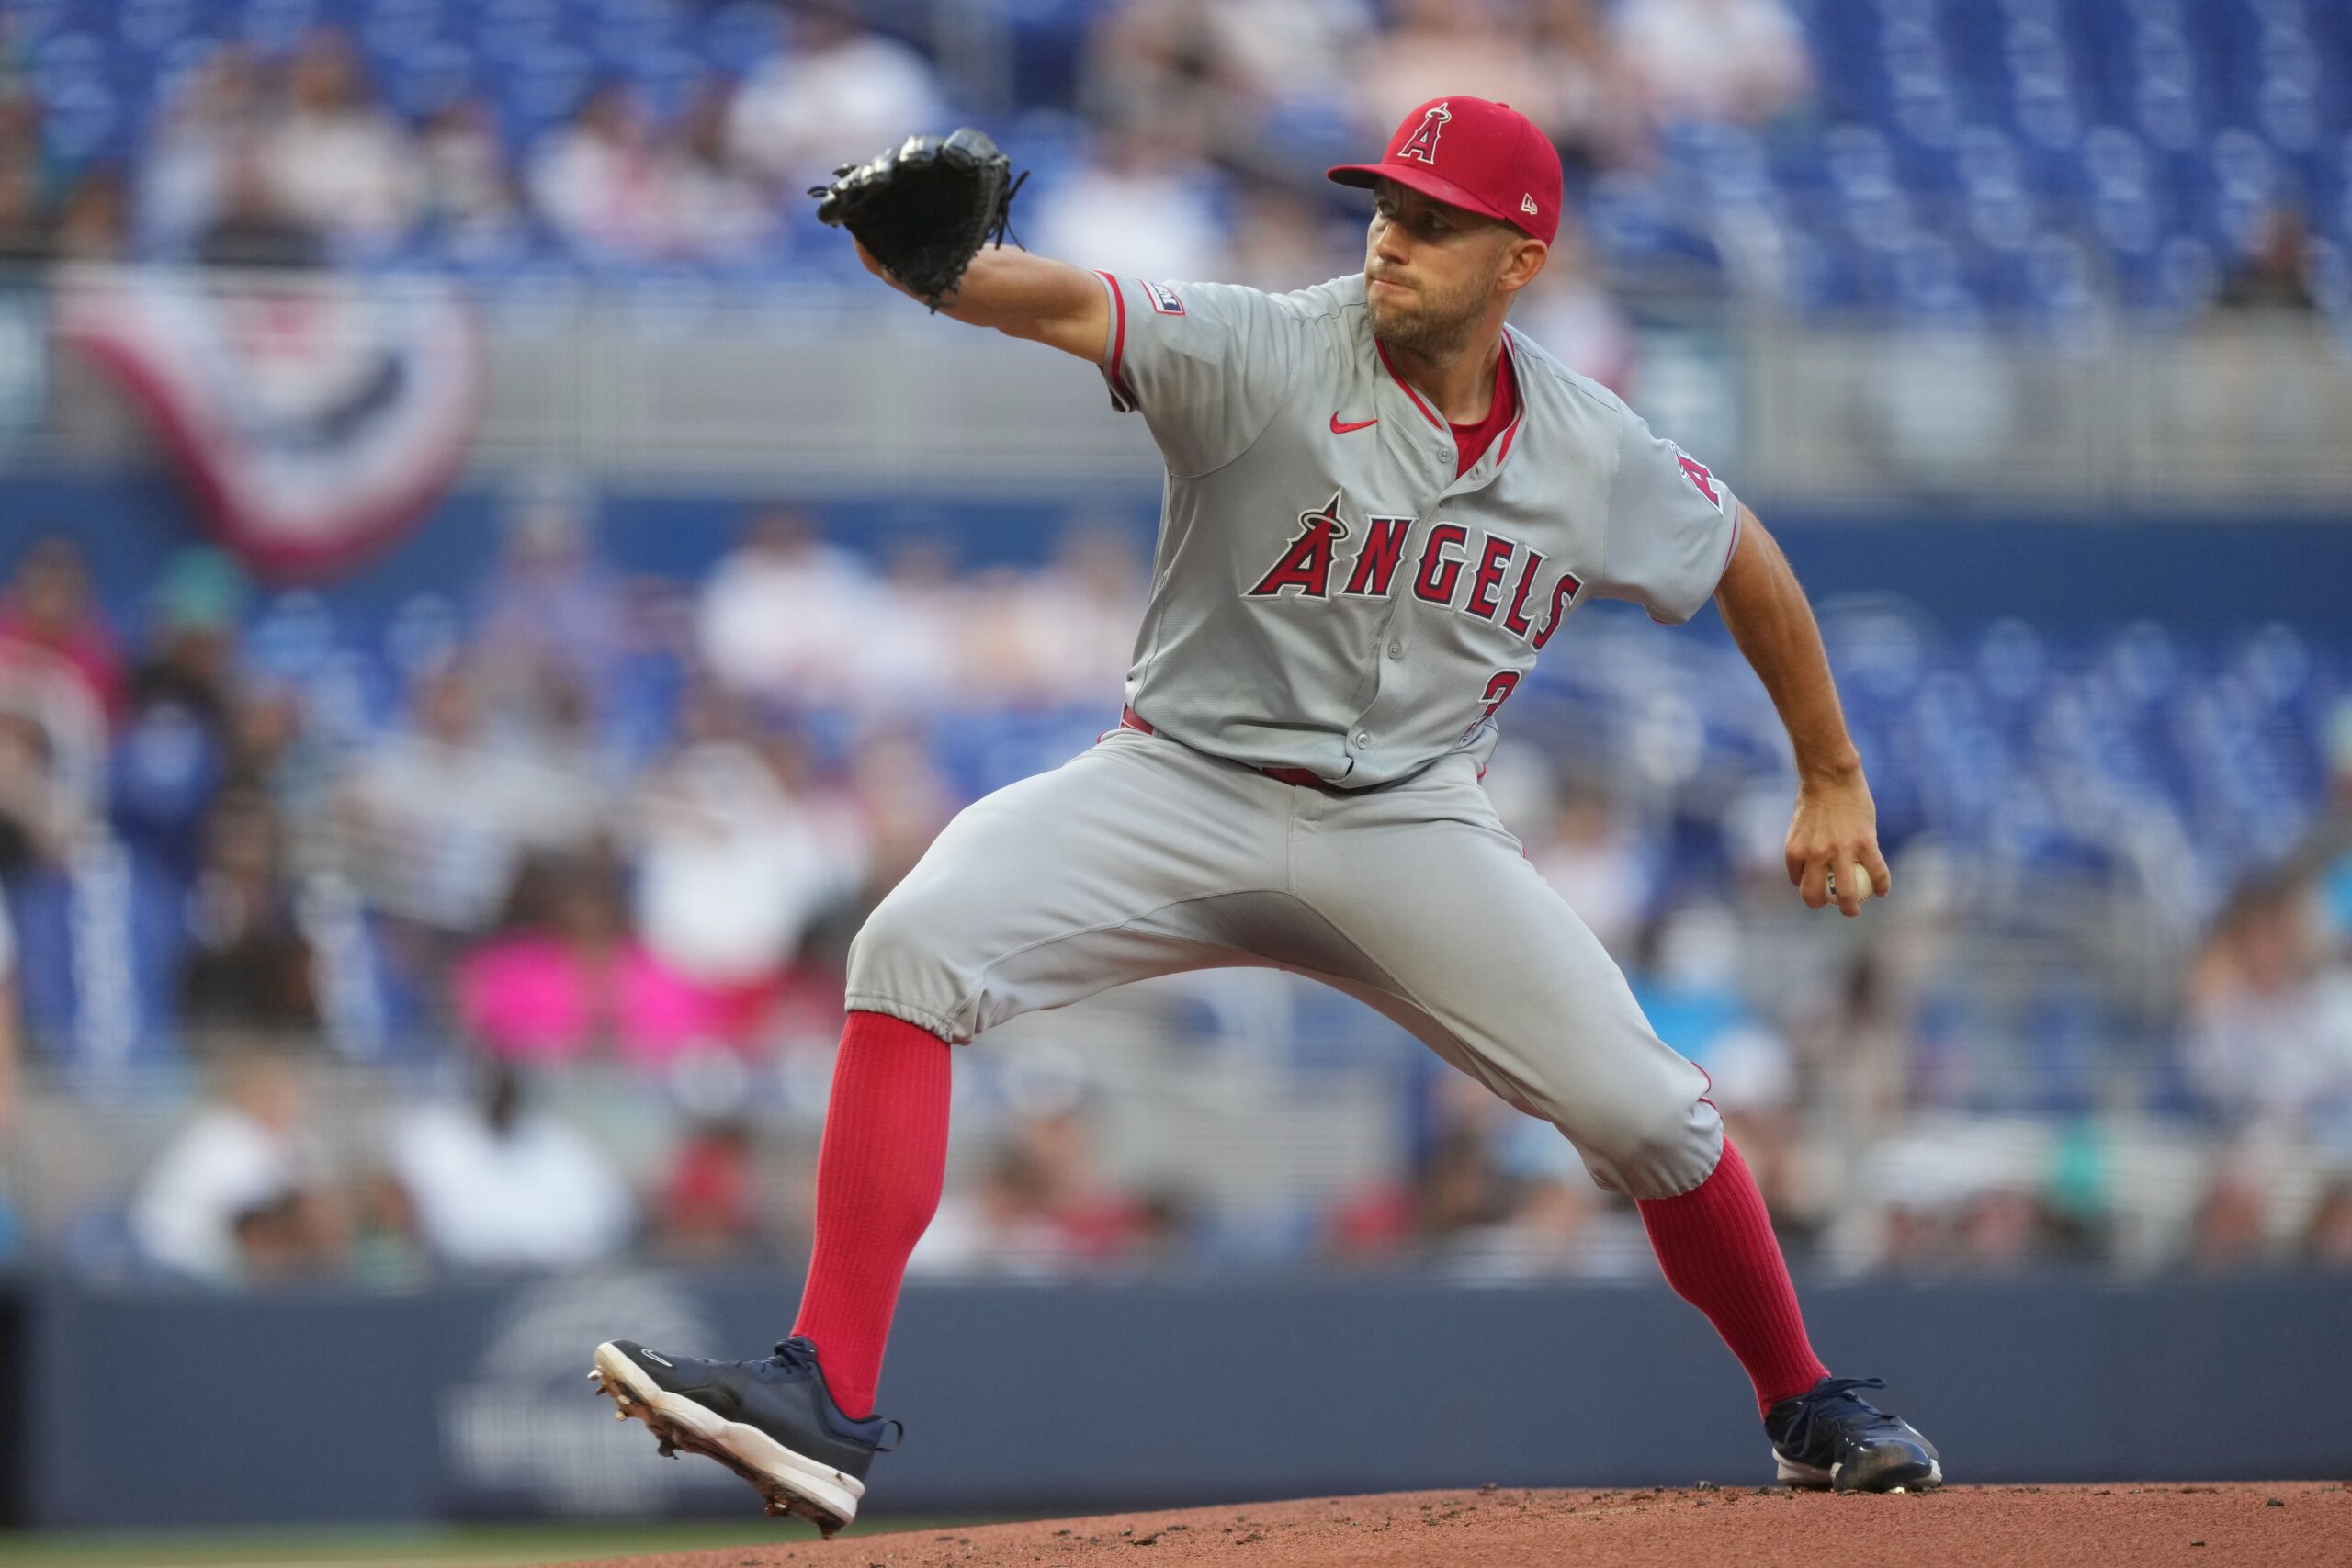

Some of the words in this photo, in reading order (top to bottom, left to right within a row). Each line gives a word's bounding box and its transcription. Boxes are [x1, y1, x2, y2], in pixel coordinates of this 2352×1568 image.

[1397, 102, 1452, 164] A
[1669, 442, 1724, 515] A
[1239, 486, 1584, 652] ANGELS
